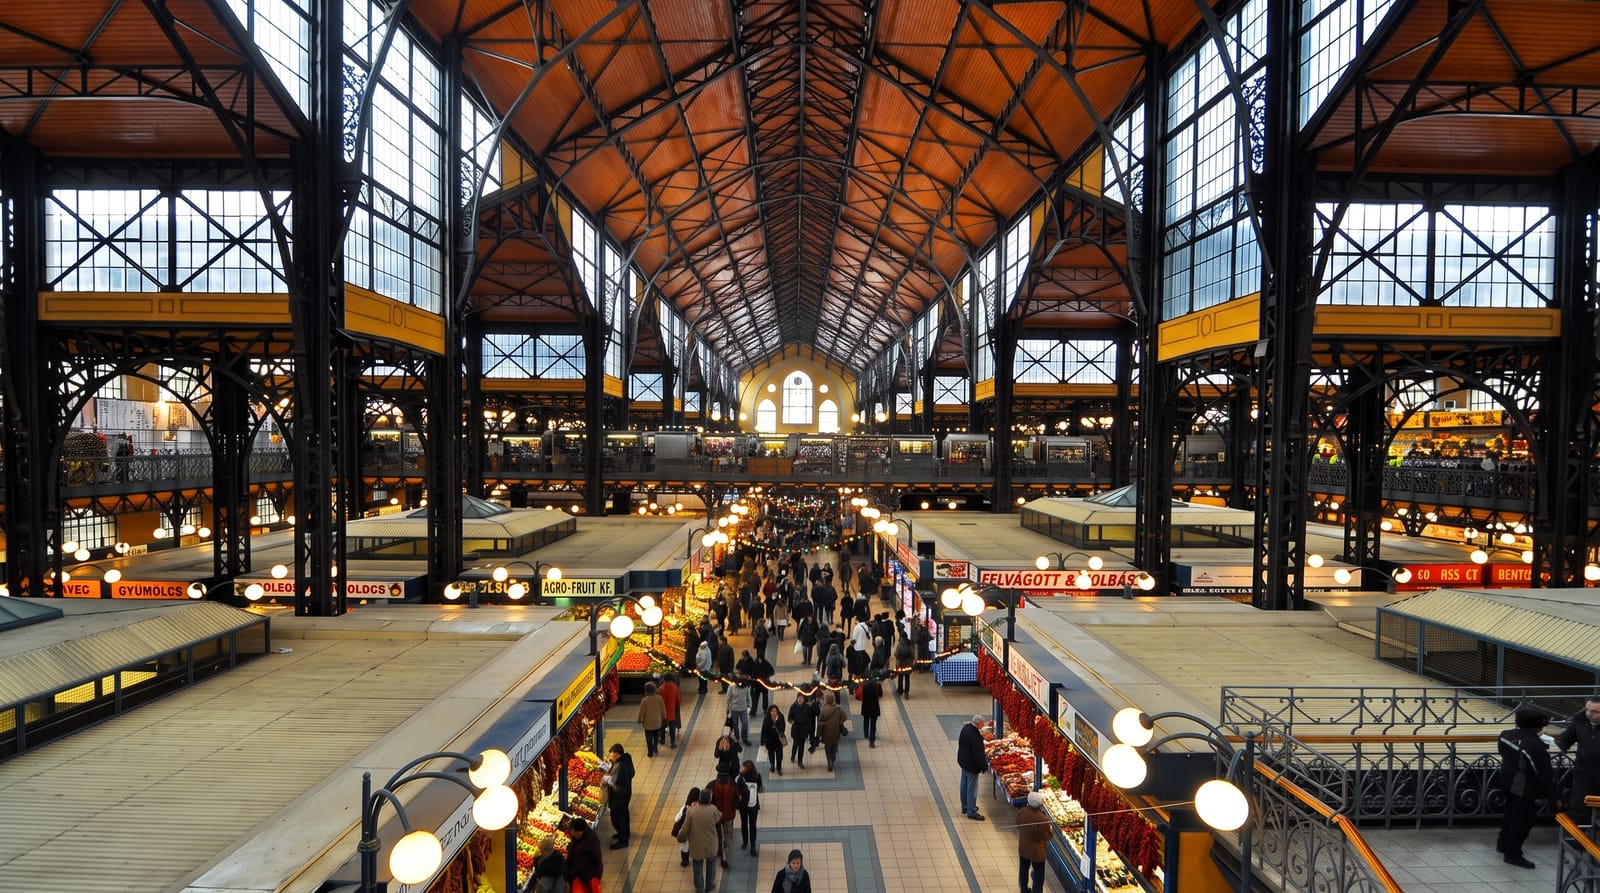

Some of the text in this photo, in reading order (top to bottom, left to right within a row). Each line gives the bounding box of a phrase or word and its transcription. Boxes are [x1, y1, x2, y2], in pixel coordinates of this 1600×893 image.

[1065, 573, 1075, 586] &
[1089, 570, 1139, 586] OLBÁS
[118, 584, 183, 596] GYÜMÖLCS
[347, 584, 386, 594] OLDCS
[544, 582, 596, 593] AGRO-FRUIT
